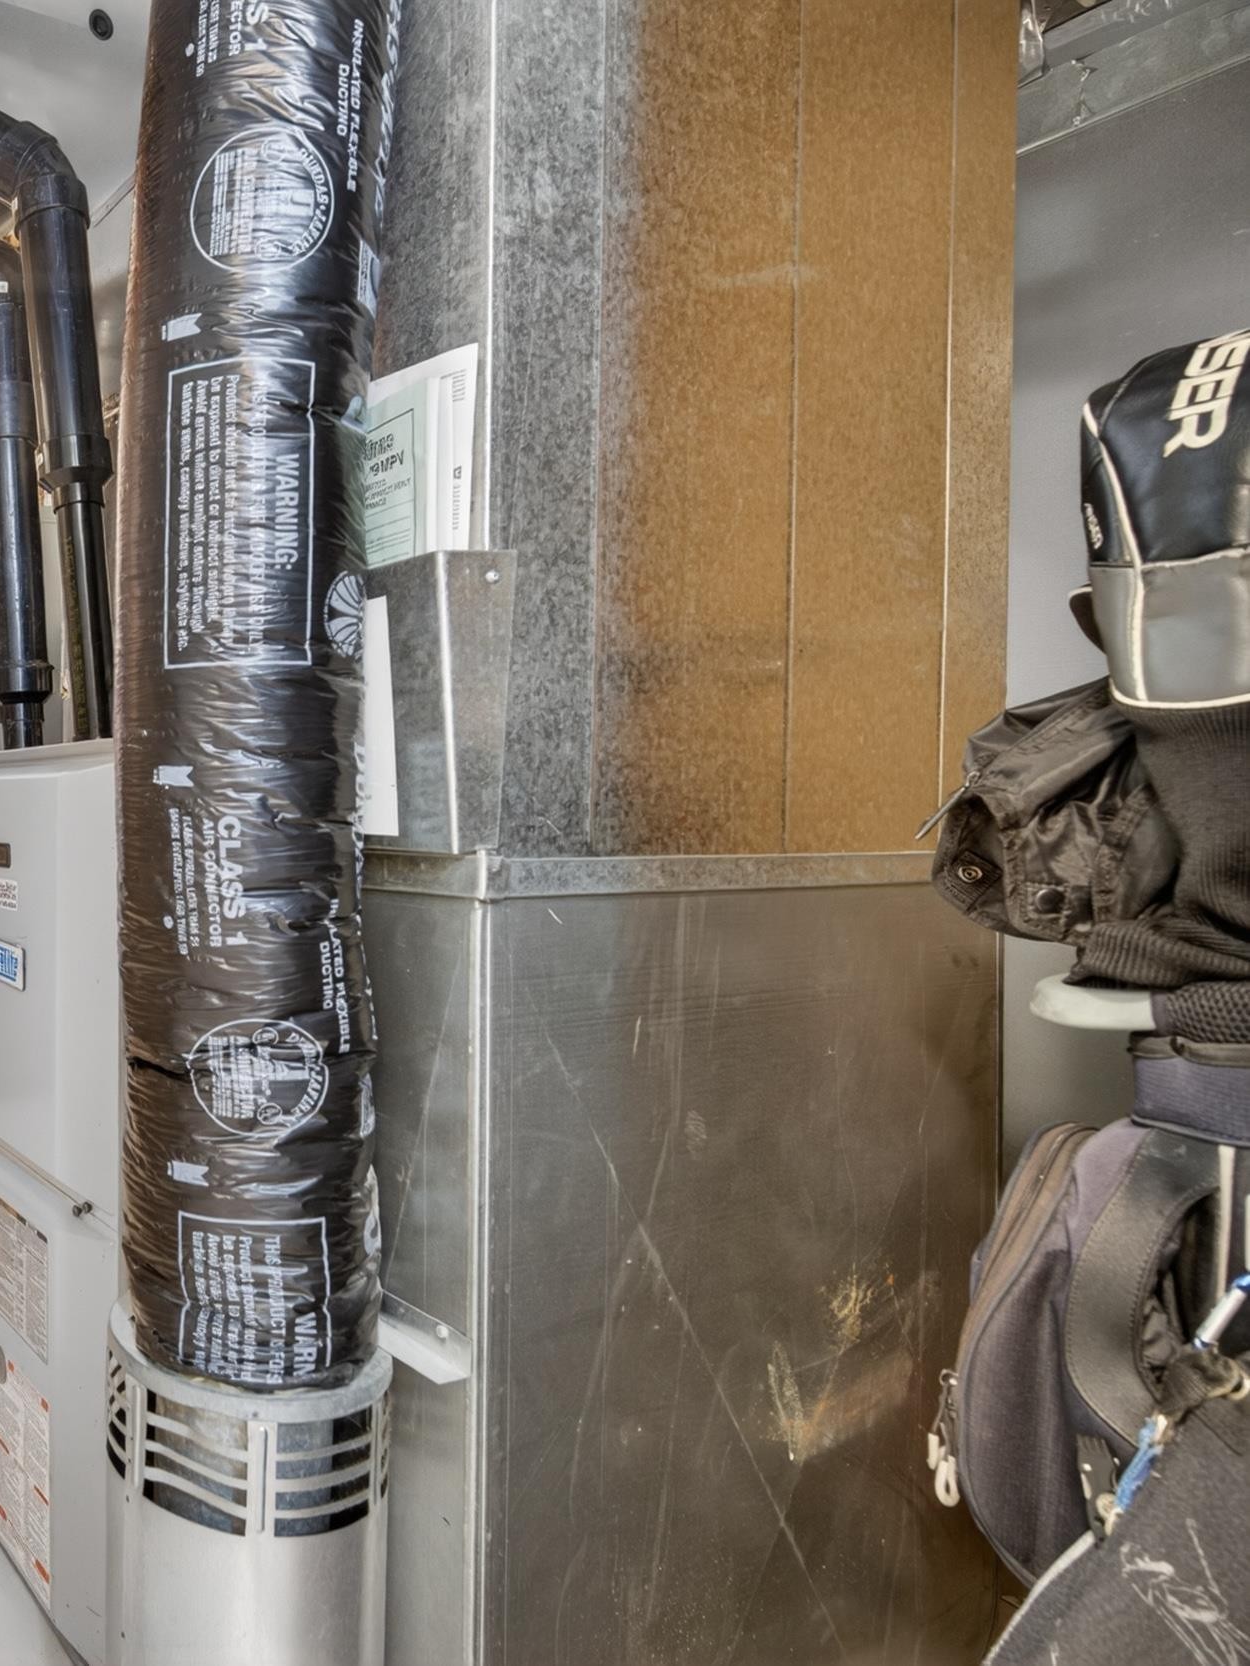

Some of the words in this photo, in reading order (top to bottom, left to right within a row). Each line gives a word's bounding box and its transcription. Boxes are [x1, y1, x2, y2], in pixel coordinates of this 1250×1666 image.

[350, 18, 365, 110] INSULATED
[336, 63, 350, 137] DUCTING
[195, 380, 208, 414] Avoid
[210, 376, 223, 392] be
[225, 375, 240, 423] Product
[194, 416, 206, 450] areas
[208, 395, 221, 447] exposed
[194, 452, 207, 491] where
[209, 449, 221, 463] to
[177, 467, 190, 511] canopy
[209, 465, 222, 501] direct
[191, 494, 205, 543] sunlight
[209, 504, 220, 516] or
[274, 453, 300, 570] WARNING:
[192, 546, 204, 582] enters
[189, 585, 205, 634] through
[202, 818, 216, 847] AIR
[217, 815, 247, 919] CLASS
[203, 849, 222, 948] CONNECTOR
[225, 931, 248, 946] 1
[319, 941, 334, 1010] DUCTING
[206, 1233, 221, 1267] Avoid
[222, 1235, 236, 1250] be
[238, 1236, 255, 1283] Product
[264, 1235, 282, 1265] THIS
